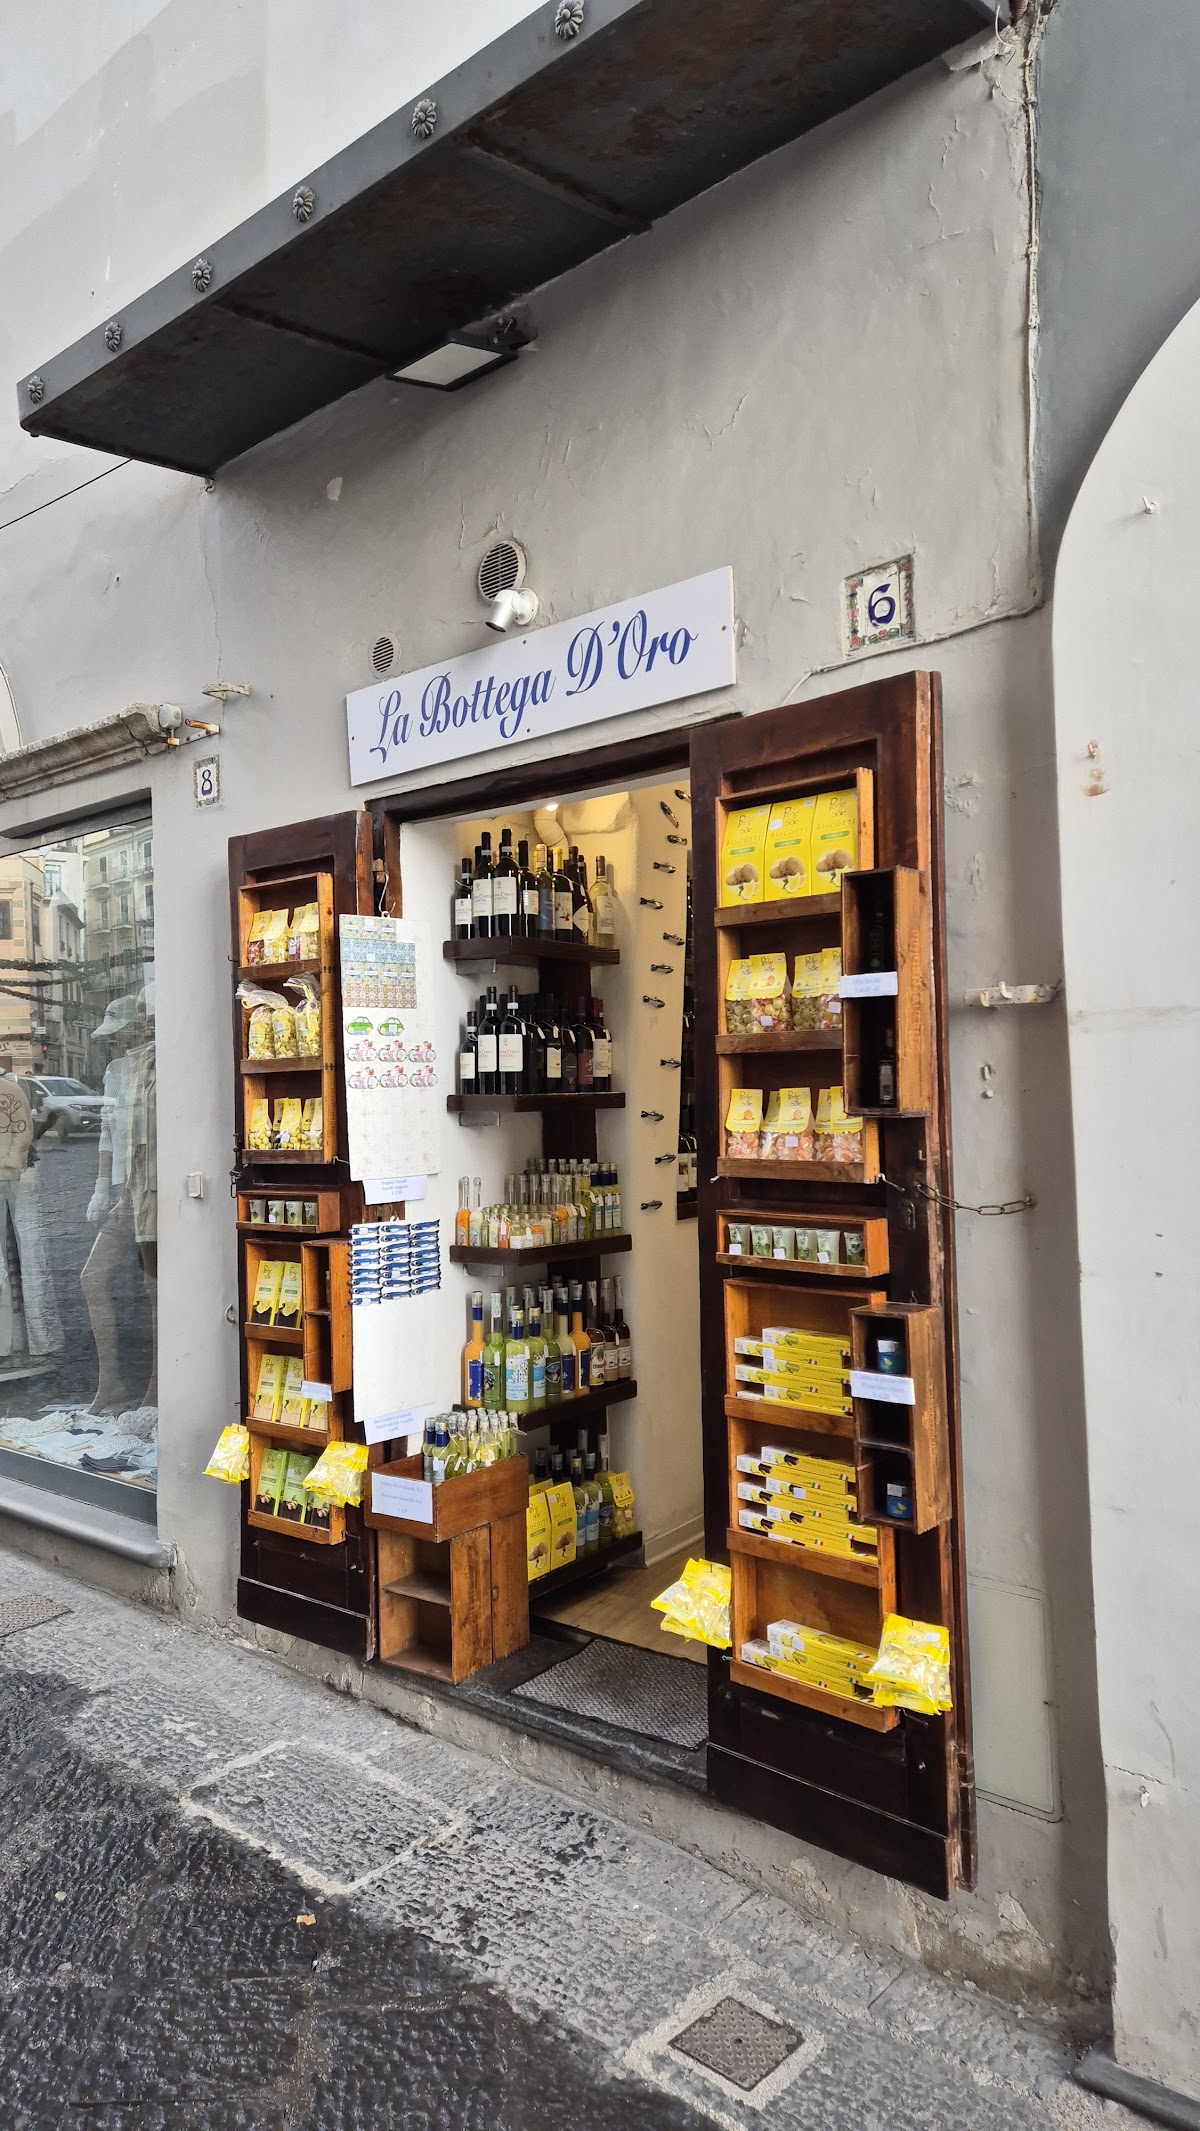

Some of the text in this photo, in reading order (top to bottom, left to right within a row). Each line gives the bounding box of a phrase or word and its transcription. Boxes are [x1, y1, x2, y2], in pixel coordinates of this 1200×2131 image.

[868, 584, 896, 629] 6
[369, 609, 699, 763] La Bottega D'Oro
[202, 769, 213, 796] 8
